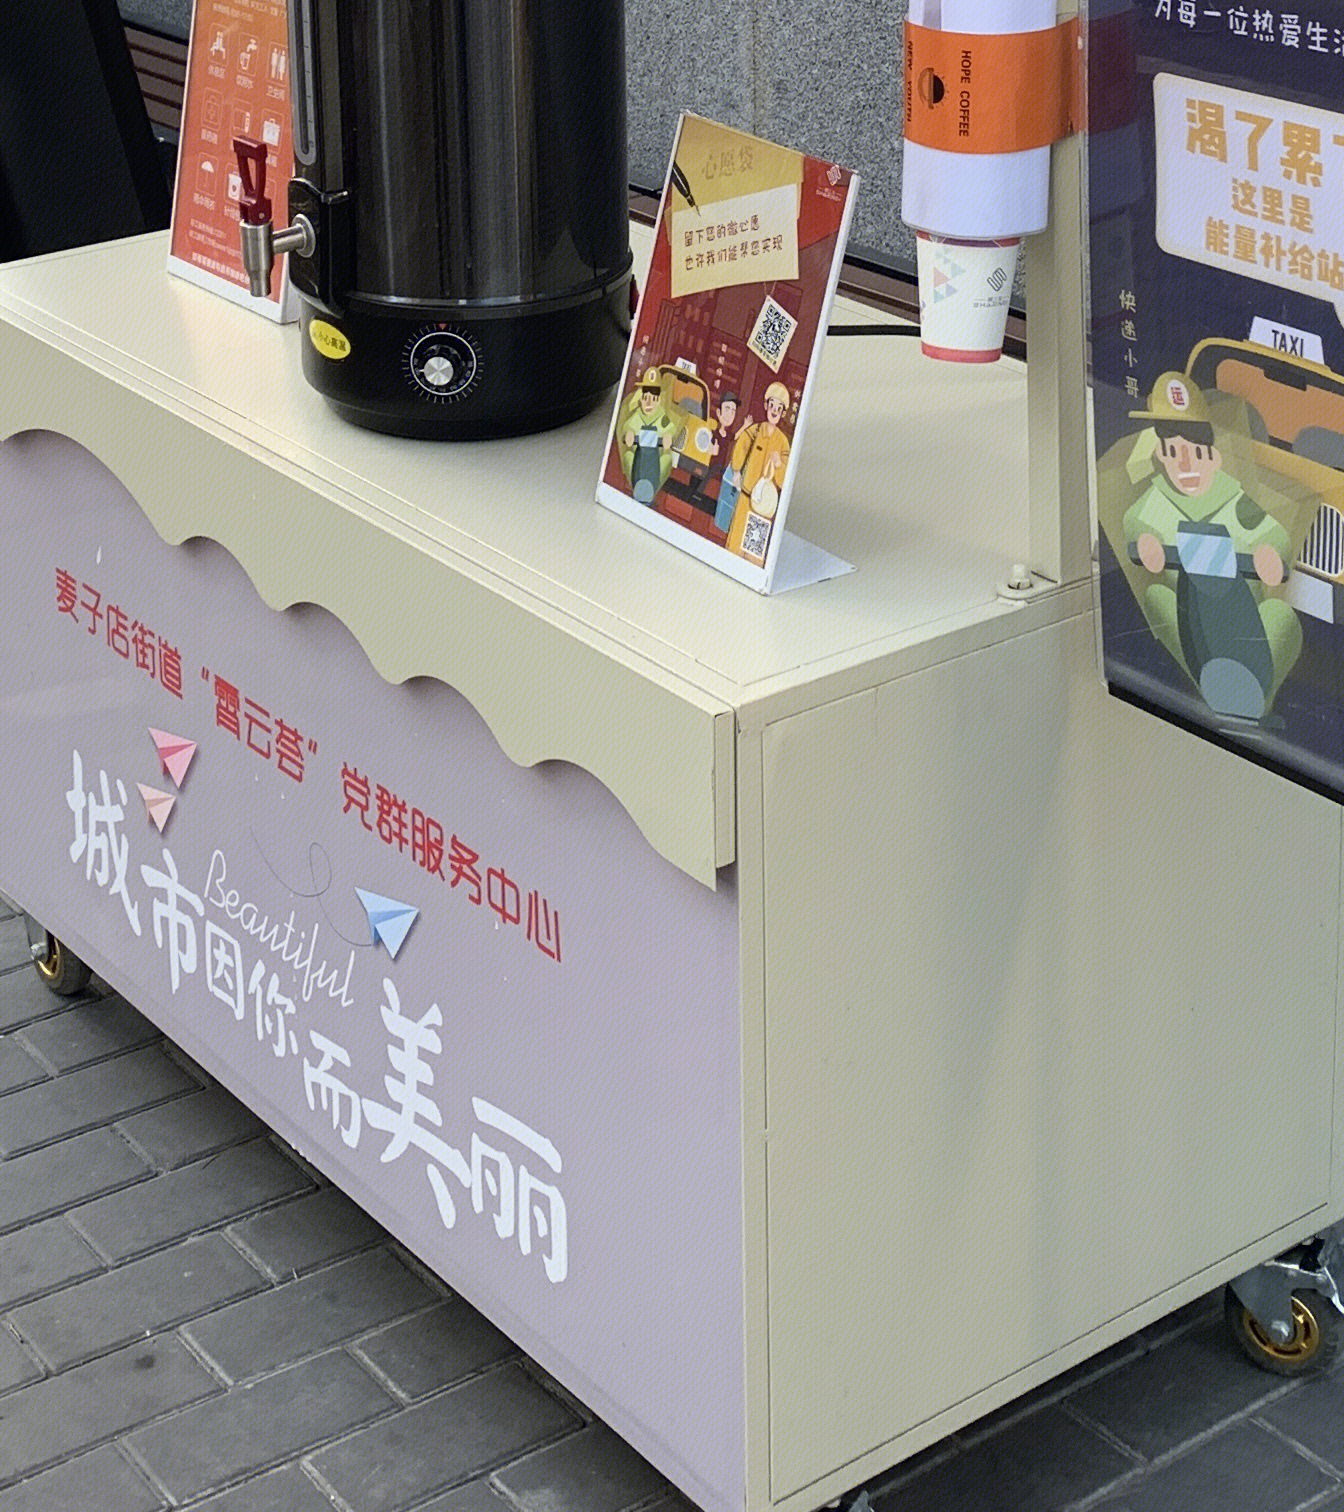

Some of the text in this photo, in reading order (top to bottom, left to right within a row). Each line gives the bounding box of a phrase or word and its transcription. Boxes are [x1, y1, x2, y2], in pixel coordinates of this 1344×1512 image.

[959, 50, 972, 136] HOPE COFFEE
[703, 144, 754, 180] 心愿袋
[1231, 178, 1315, 234] 这里是
[1119, 289, 1139, 399] 快递小哥
[1271, 329, 1305, 358] TAXI
[202, 849, 356, 1010] Beautiful
[66, 749, 569, 1284] 城市因你而美丽
